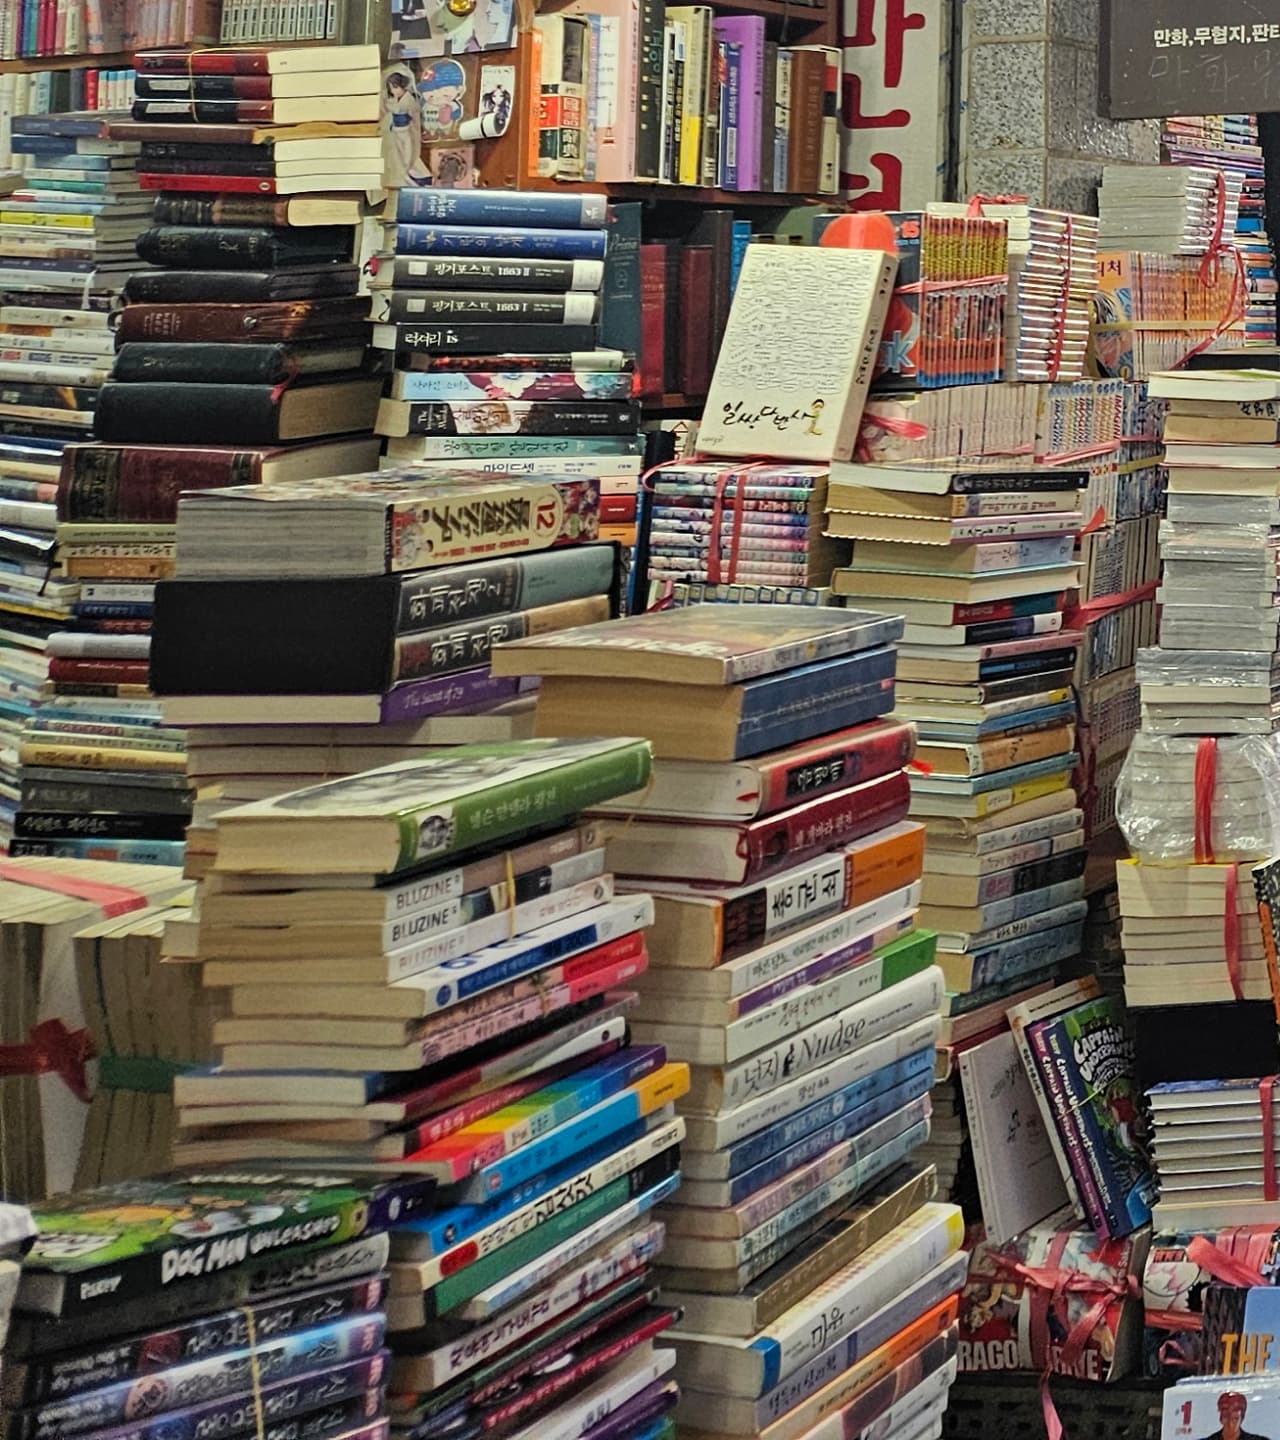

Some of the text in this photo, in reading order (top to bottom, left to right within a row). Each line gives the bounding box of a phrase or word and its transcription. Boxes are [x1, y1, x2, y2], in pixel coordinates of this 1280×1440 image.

[446, 329, 459, 345] is
[396, 878, 452, 907] BLUZINE
[744, 1051, 779, 1091] 넛지
[801, 1016, 867, 1059] Nudge
[1073, 1024, 1124, 1063] CAPTAIN
[161, 1246, 205, 1286] DOG
[204, 1231, 250, 1273] MAN
[1219, 1333, 1272, 1375] THE
